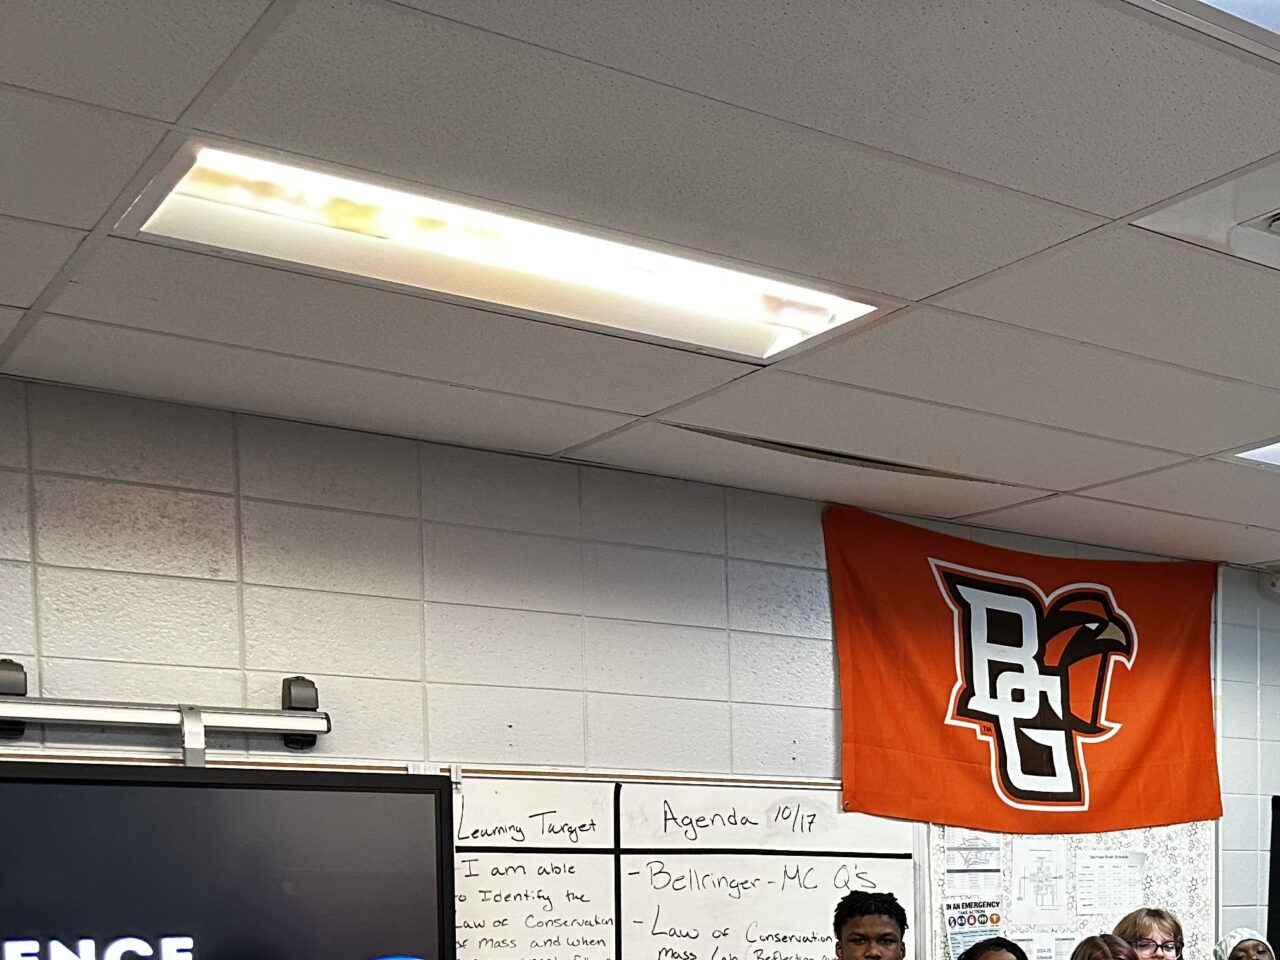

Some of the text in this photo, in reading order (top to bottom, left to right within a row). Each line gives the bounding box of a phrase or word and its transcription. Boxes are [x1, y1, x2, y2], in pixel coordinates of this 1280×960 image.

[458, 795, 597, 843] Learning Target
[663, 800, 817, 841] Agenda 10/17
[461, 858, 577, 878] I am able
[781, 864, 819, 891] MC
[478, 889, 553, 912] Identify
[566, 889, 591, 903] the
[952, 902, 961, 910] AN
[961, 901, 1001, 910] EMERGENCY
[492, 917, 509, 928] of
[651, 904, 833, 943] Law of Conservation
[529, 936, 561, 949] and
[566, 935, 607, 948] when
